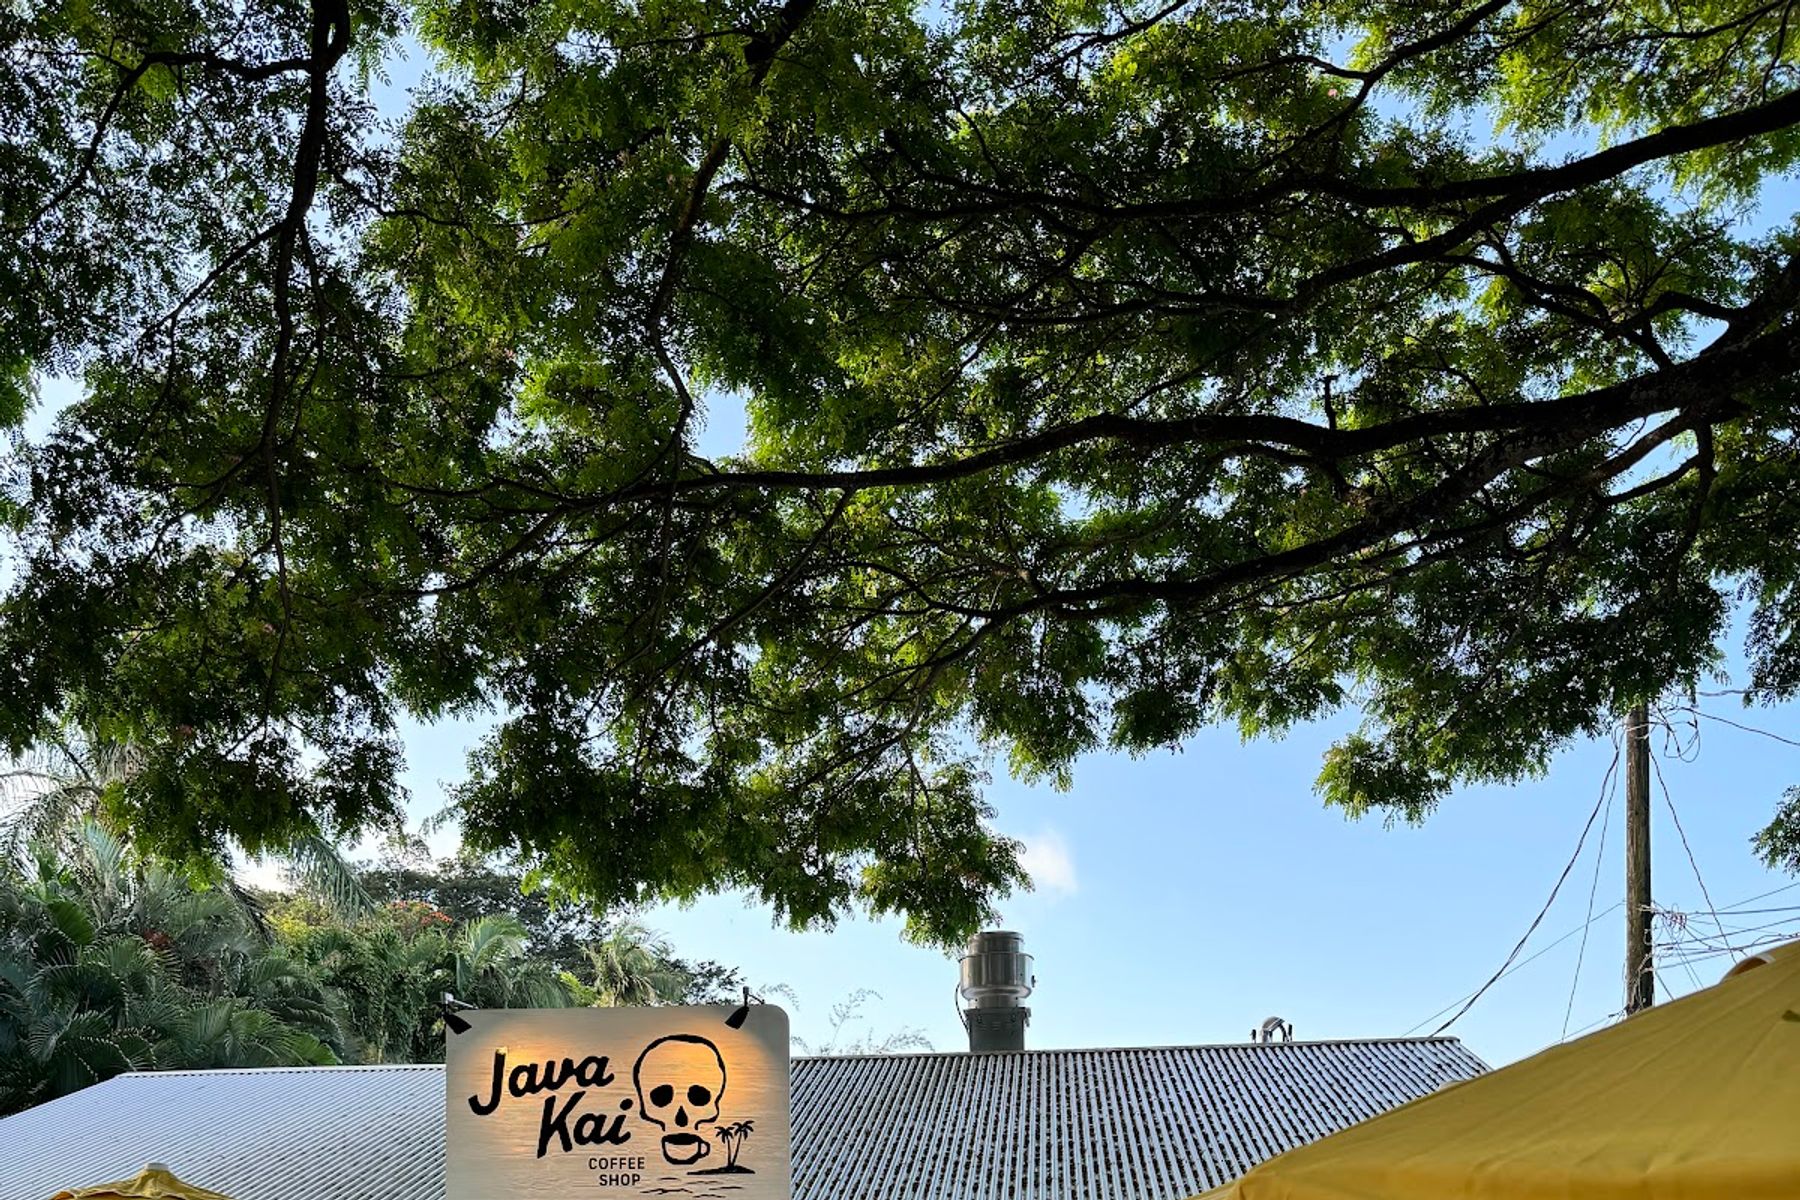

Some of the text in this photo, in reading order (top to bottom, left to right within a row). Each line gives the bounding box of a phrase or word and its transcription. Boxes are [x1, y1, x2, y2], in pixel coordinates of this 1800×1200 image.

[468, 1047, 615, 1116] Java
[536, 1091, 634, 1159] Kai
[588, 1157, 645, 1170] COFFEE
[598, 1174, 641, 1186] SHOP
